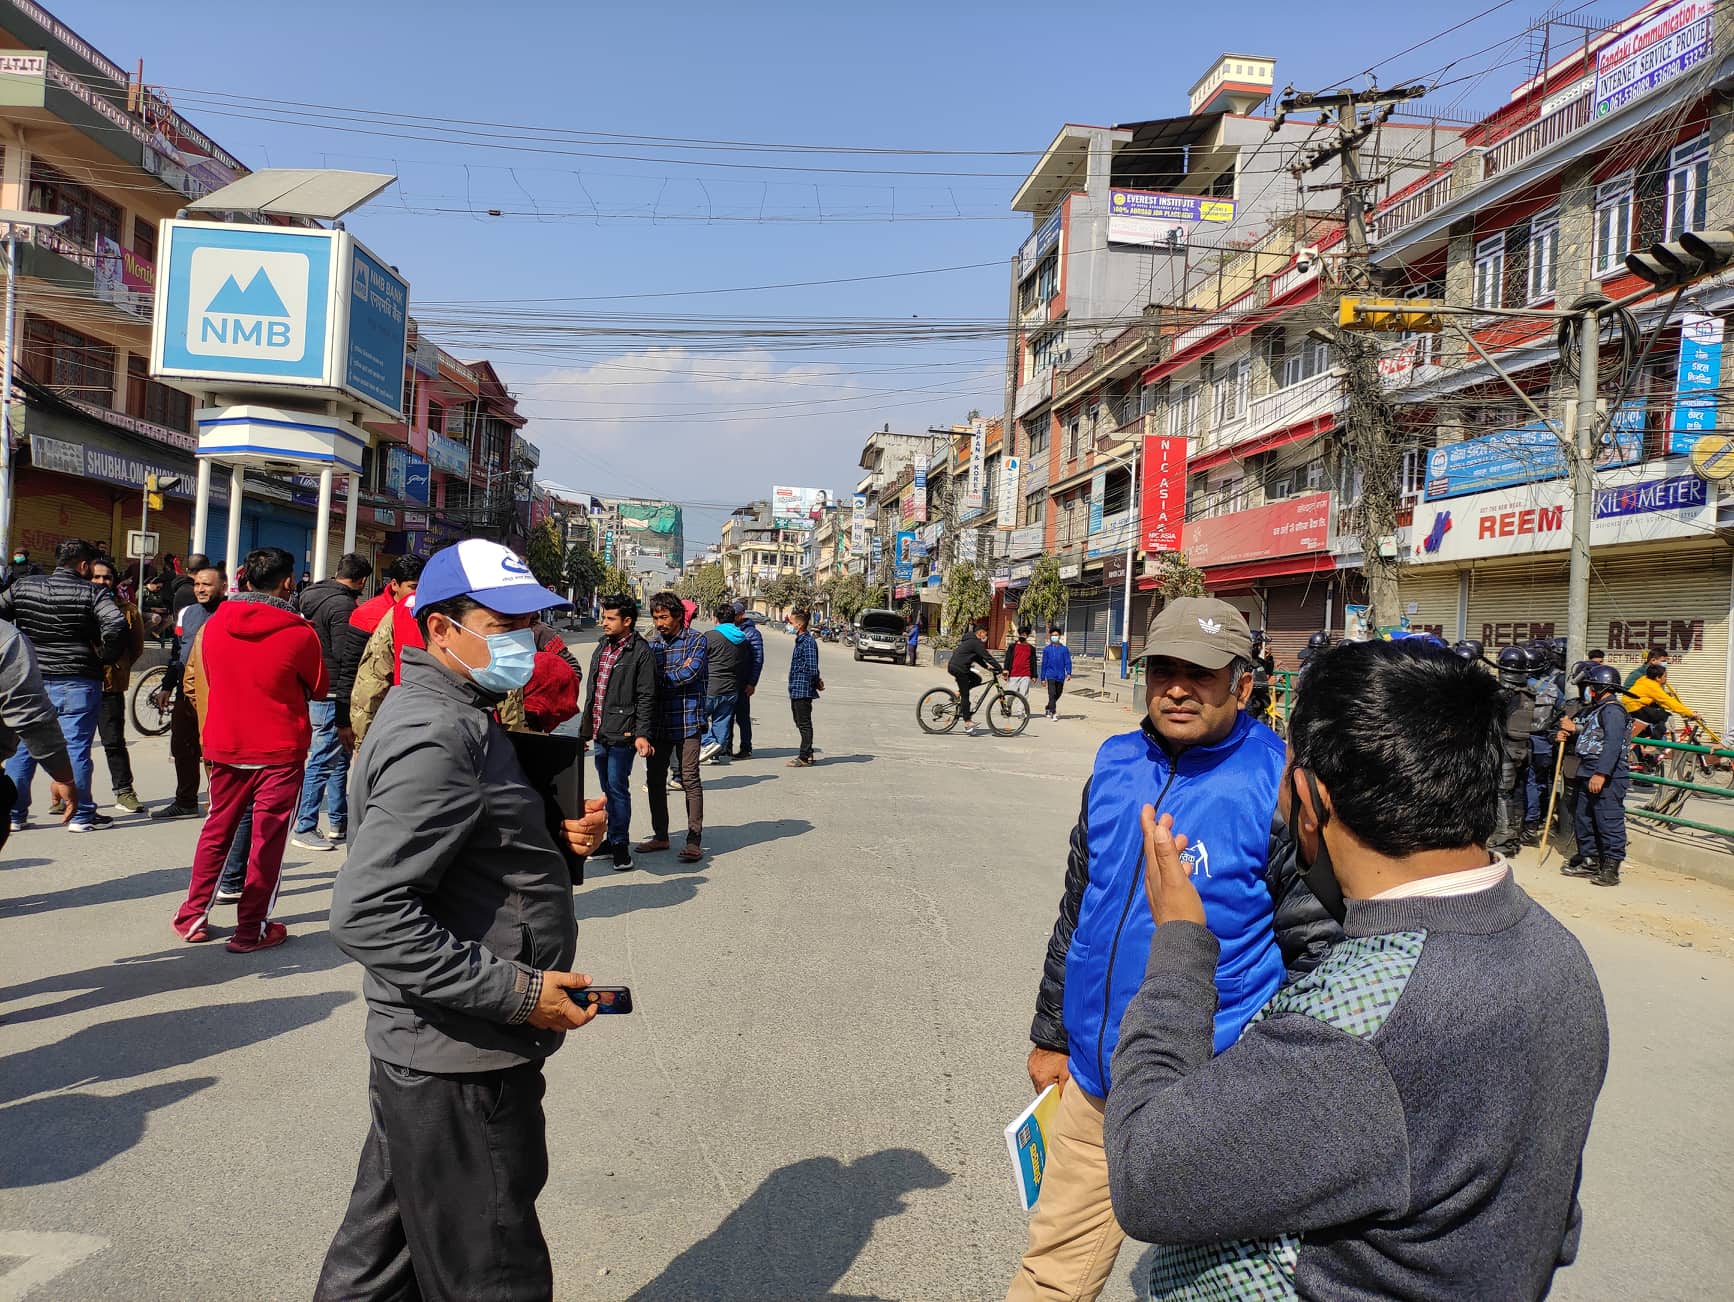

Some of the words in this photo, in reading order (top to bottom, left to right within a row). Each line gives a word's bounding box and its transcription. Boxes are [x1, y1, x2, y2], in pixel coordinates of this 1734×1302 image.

[1633, 4, 1696, 53] Communication
[1600, 61, 1637, 97] INTERNET
[1640, 40, 1672, 74] SERVICE
[1127, 194, 1157, 205] EVEREST
[1159, 197, 1195, 208] INSTITUTE
[371, 270, 385, 292] NMB
[386, 282, 402, 303] BANK
[201, 316, 291, 347] NMB
[87, 451, 128, 480] SHUBHA
[130, 462, 144, 484] OM
[1161, 440, 1170, 472] NIC
[973, 464, 981, 494] KOREA
[1159, 478, 1169, 521] ASIA
[1478, 505, 1563, 540] REEM
[1482, 623, 1555, 647] REEM
[1608, 620, 1704, 650] REEM
